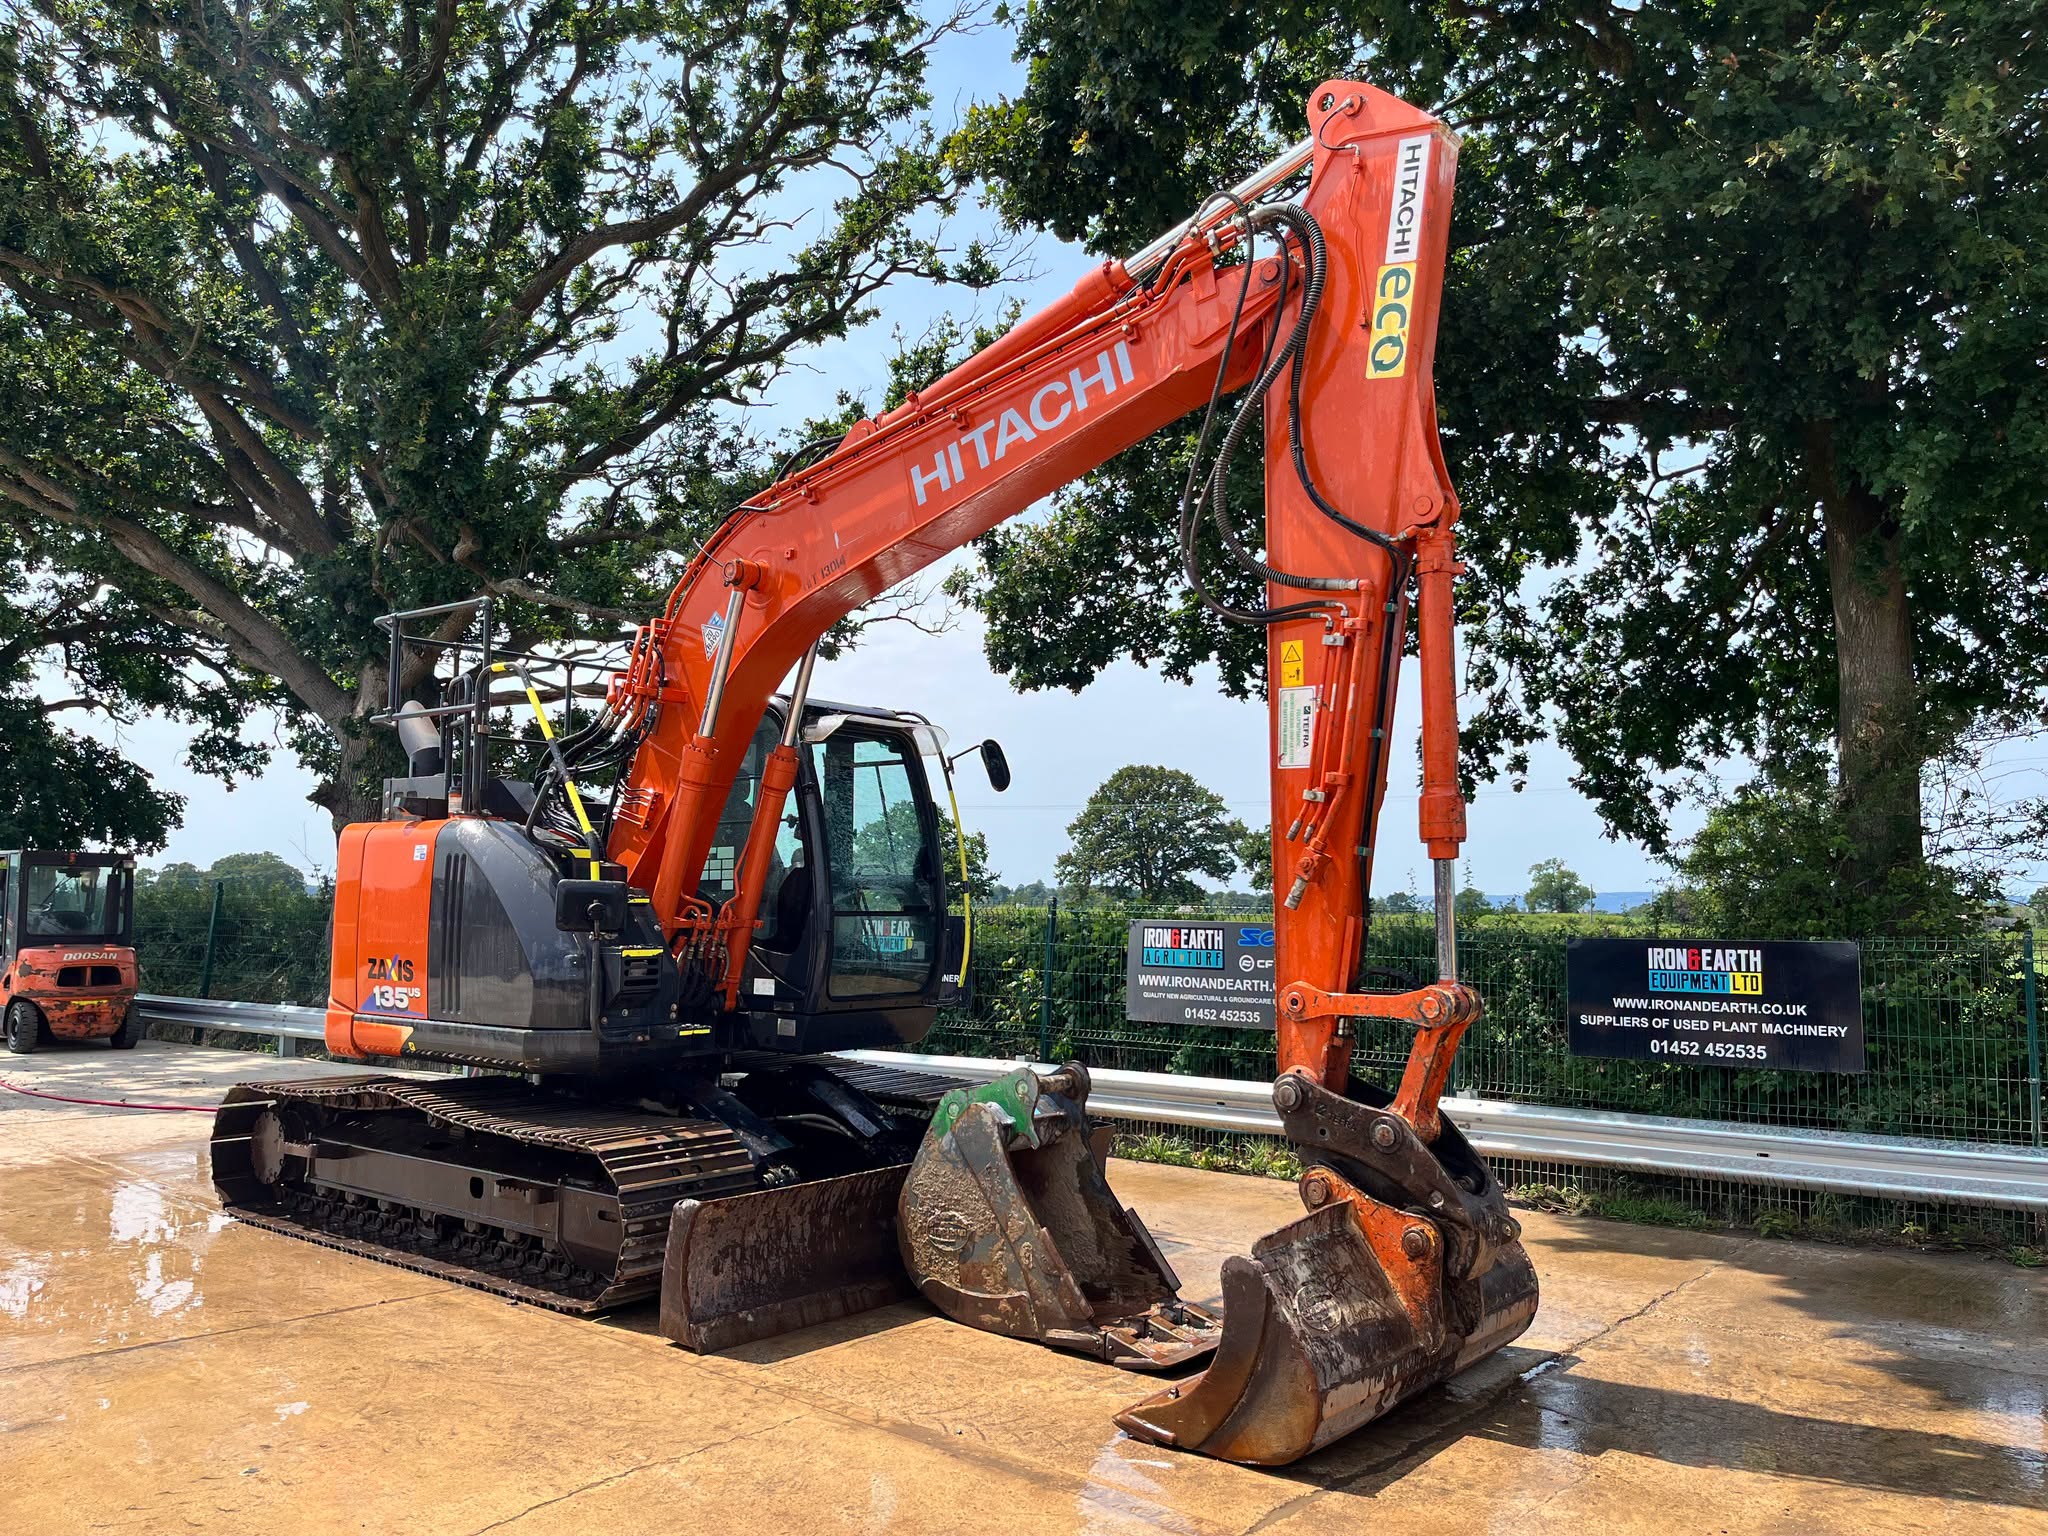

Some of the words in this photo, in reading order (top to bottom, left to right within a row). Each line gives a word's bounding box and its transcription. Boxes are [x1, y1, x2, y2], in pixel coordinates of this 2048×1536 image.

[1393, 143, 1422, 255] HITACHI
[910, 341, 1136, 506] HITACHI
[63, 952, 118, 961] DOOSAN
[1145, 949, 1175, 965] AGRI
[1188, 951, 1221, 966] TURF
[368, 954, 414, 982] ZAXIS
[1651, 972, 1728, 990] EQUIPMENT
[1732, 974, 1759, 991] LTD
[1143, 991, 1166, 999] QUALITY
[1179, 993, 1222, 1002] AGRICULTURAL
[1229, 996, 1272, 1005] GROUNDCARE
[1612, 997, 1808, 1016] WWW.IRONANDEARTH.CO.UK
[1184, 1007, 1217, 1021] 01452
[1219, 1010, 1261, 1023] 452535
[1580, 1014, 1649, 1028] SUPPLIERS
[1652, 1018, 1670, 1029] OF
[1673, 1019, 1710, 1031] USED
[1713, 1021, 1758, 1033] PLANT
[1761, 1023, 1849, 1038] MACHINERY
[1650, 1039, 1700, 1056] 01452
[1704, 1042, 1767, 1060] 452535
